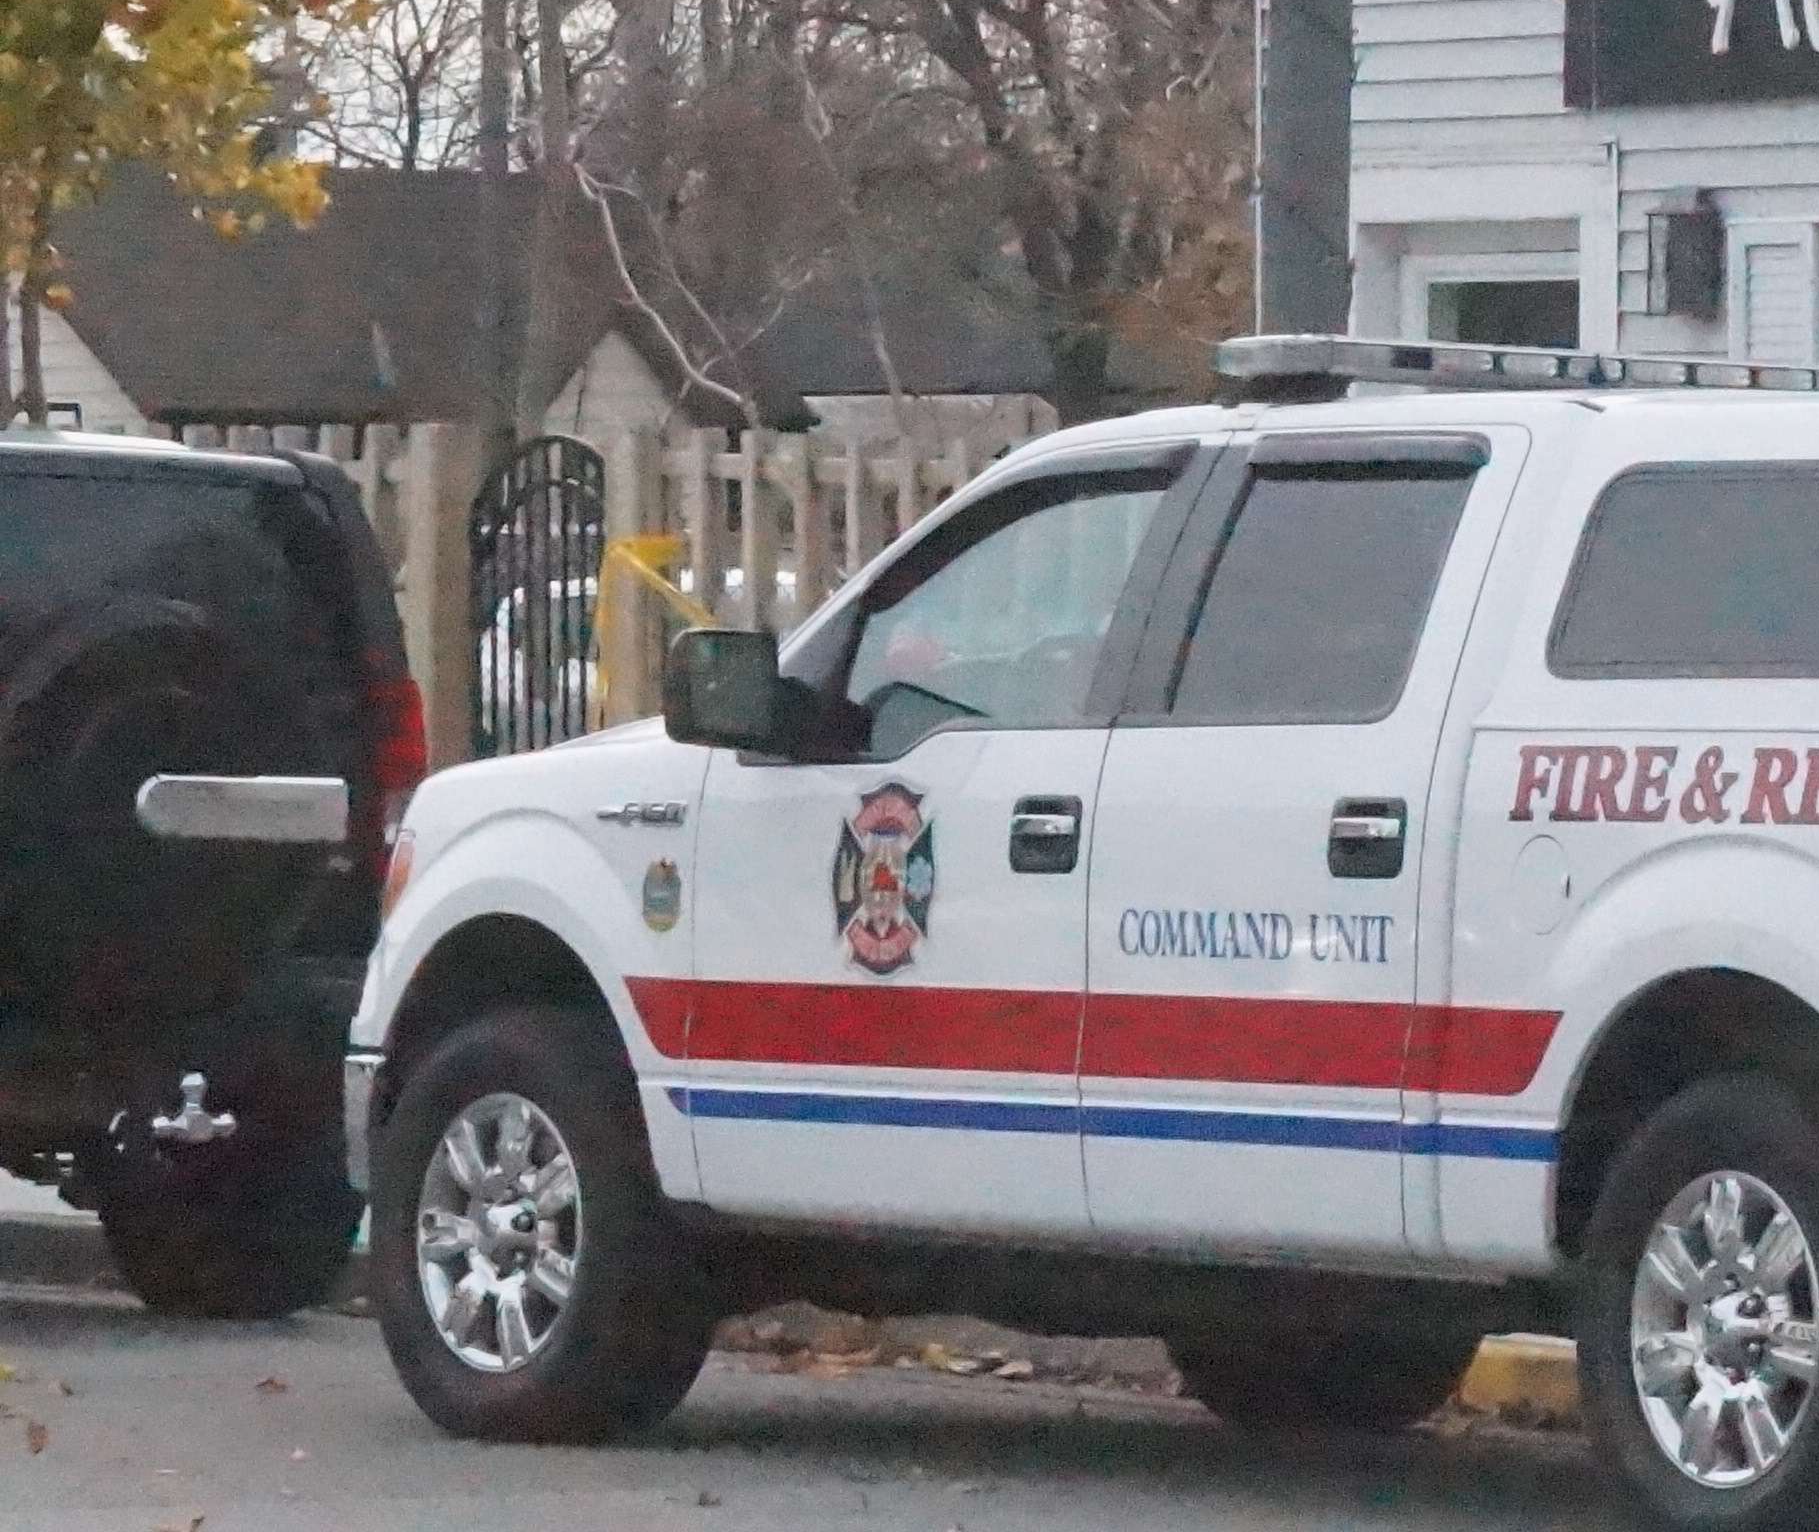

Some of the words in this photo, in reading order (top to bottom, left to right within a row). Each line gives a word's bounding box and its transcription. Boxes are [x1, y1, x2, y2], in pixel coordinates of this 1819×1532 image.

[1508, 745, 1677, 822] FIRE
[1118, 908, 1293, 961] COMMAND
[1309, 914, 1395, 964] UNIT
